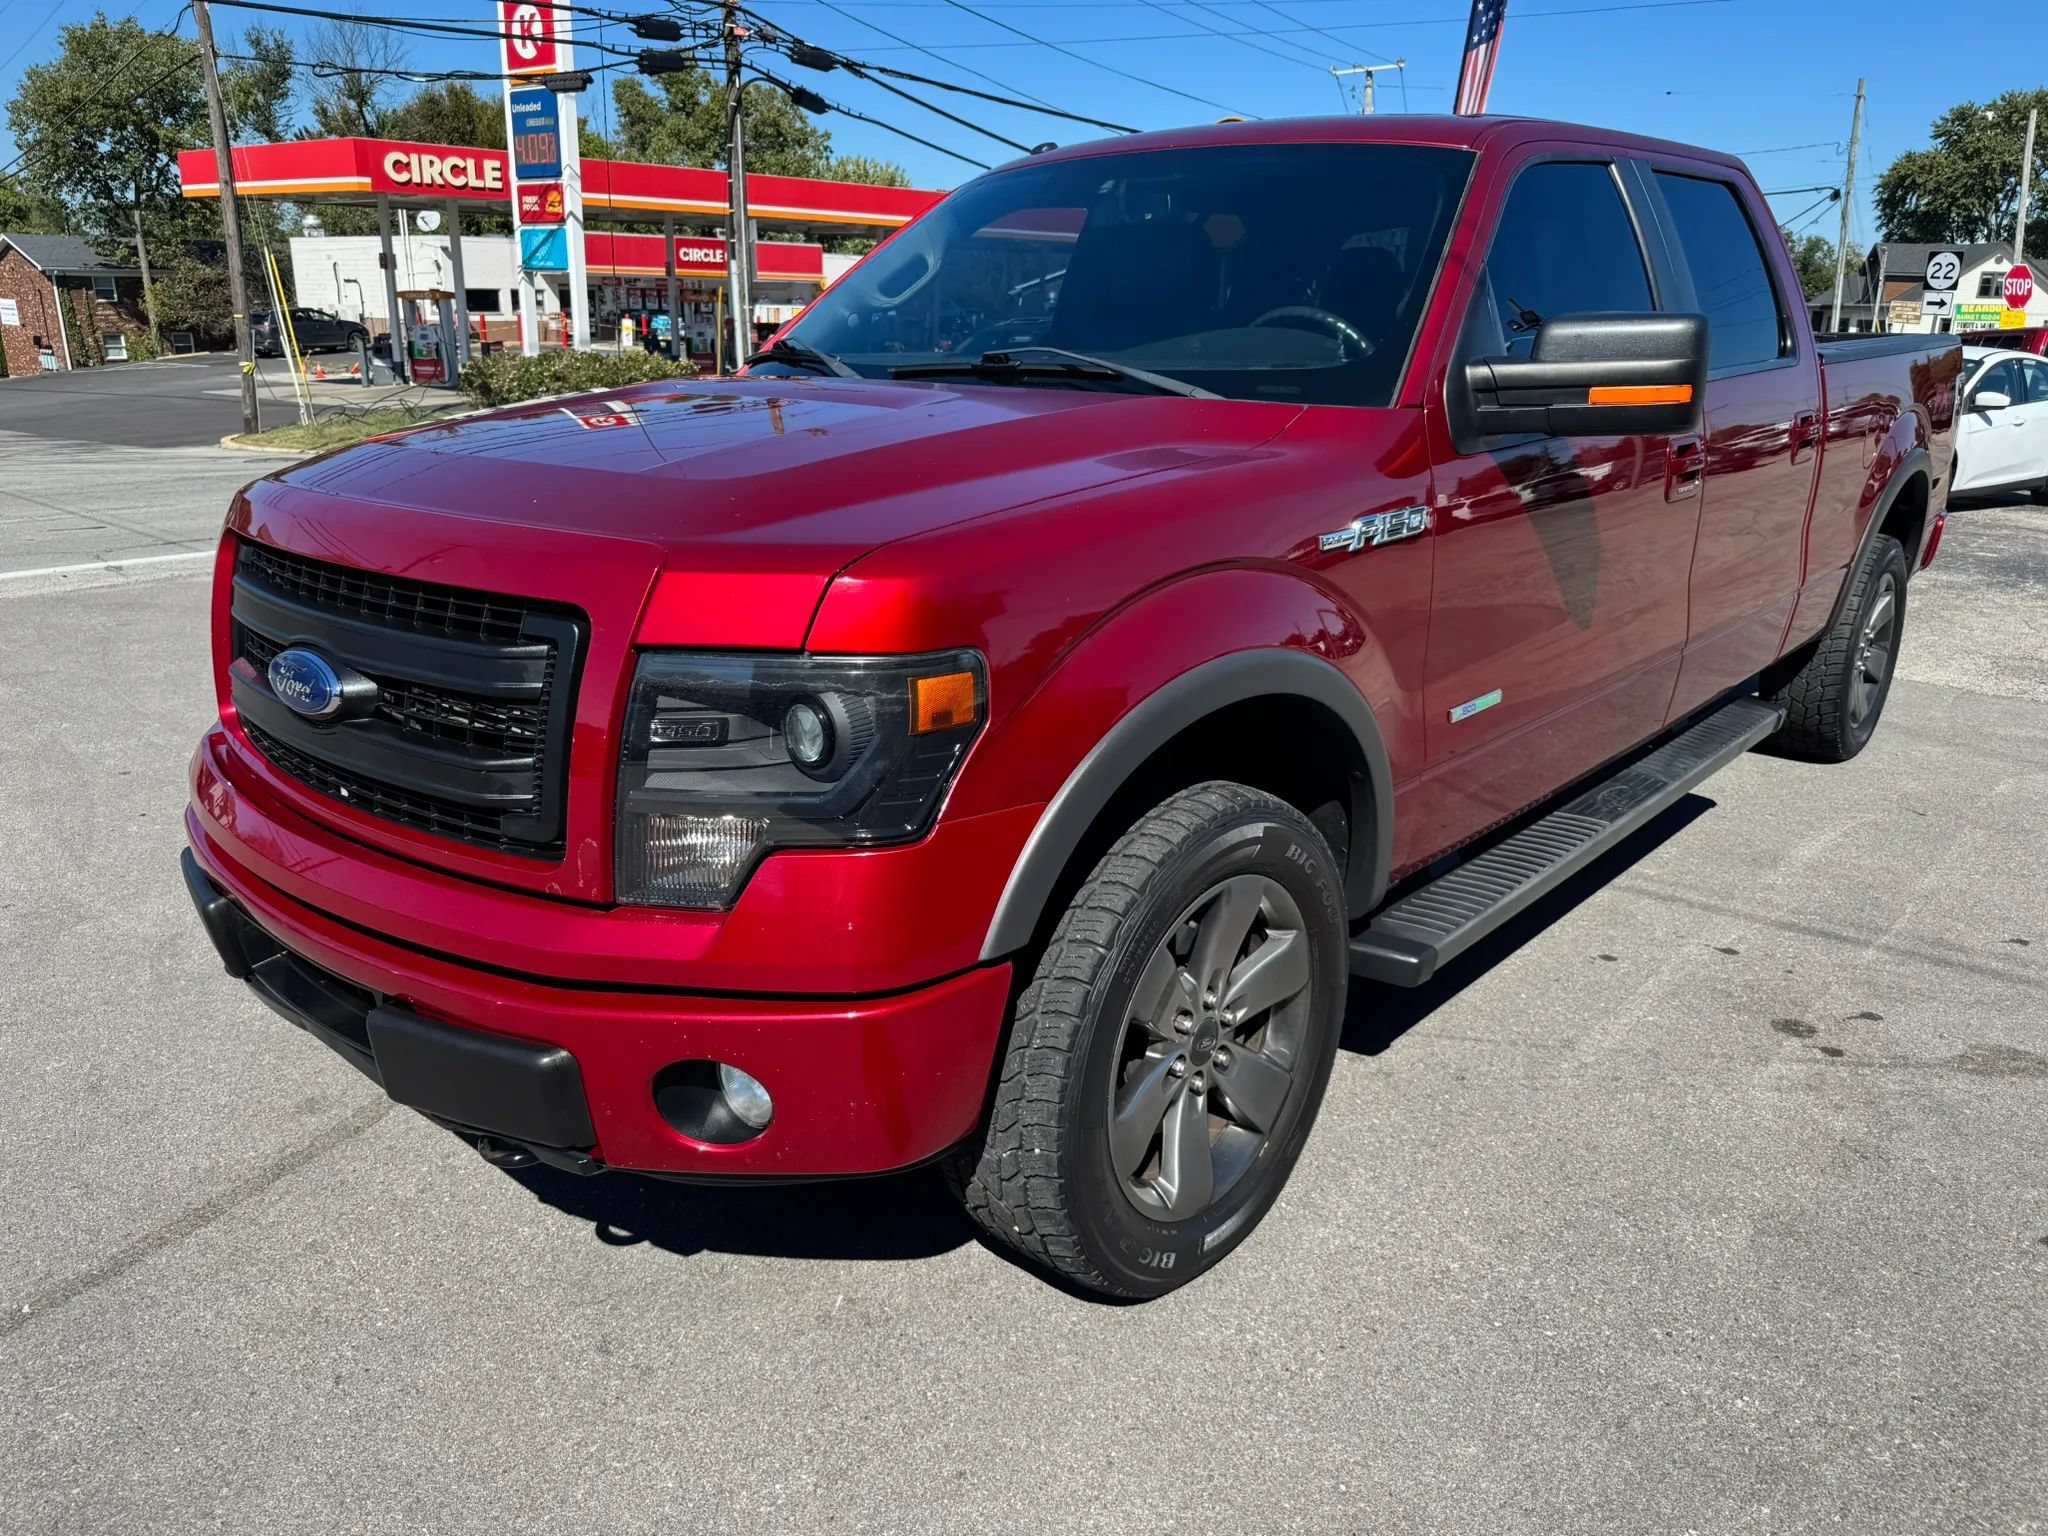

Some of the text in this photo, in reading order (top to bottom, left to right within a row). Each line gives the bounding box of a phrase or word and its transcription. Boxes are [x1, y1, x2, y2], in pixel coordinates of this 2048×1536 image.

[511, 101, 542, 113] Unleaded
[383, 151, 503, 191] CIRCLE
[679, 246, 724, 263] CIRCLE
[1930, 262, 1956, 280] 22
[2004, 278, 2032, 296] STOP
[275, 658, 316, 702] Ford
